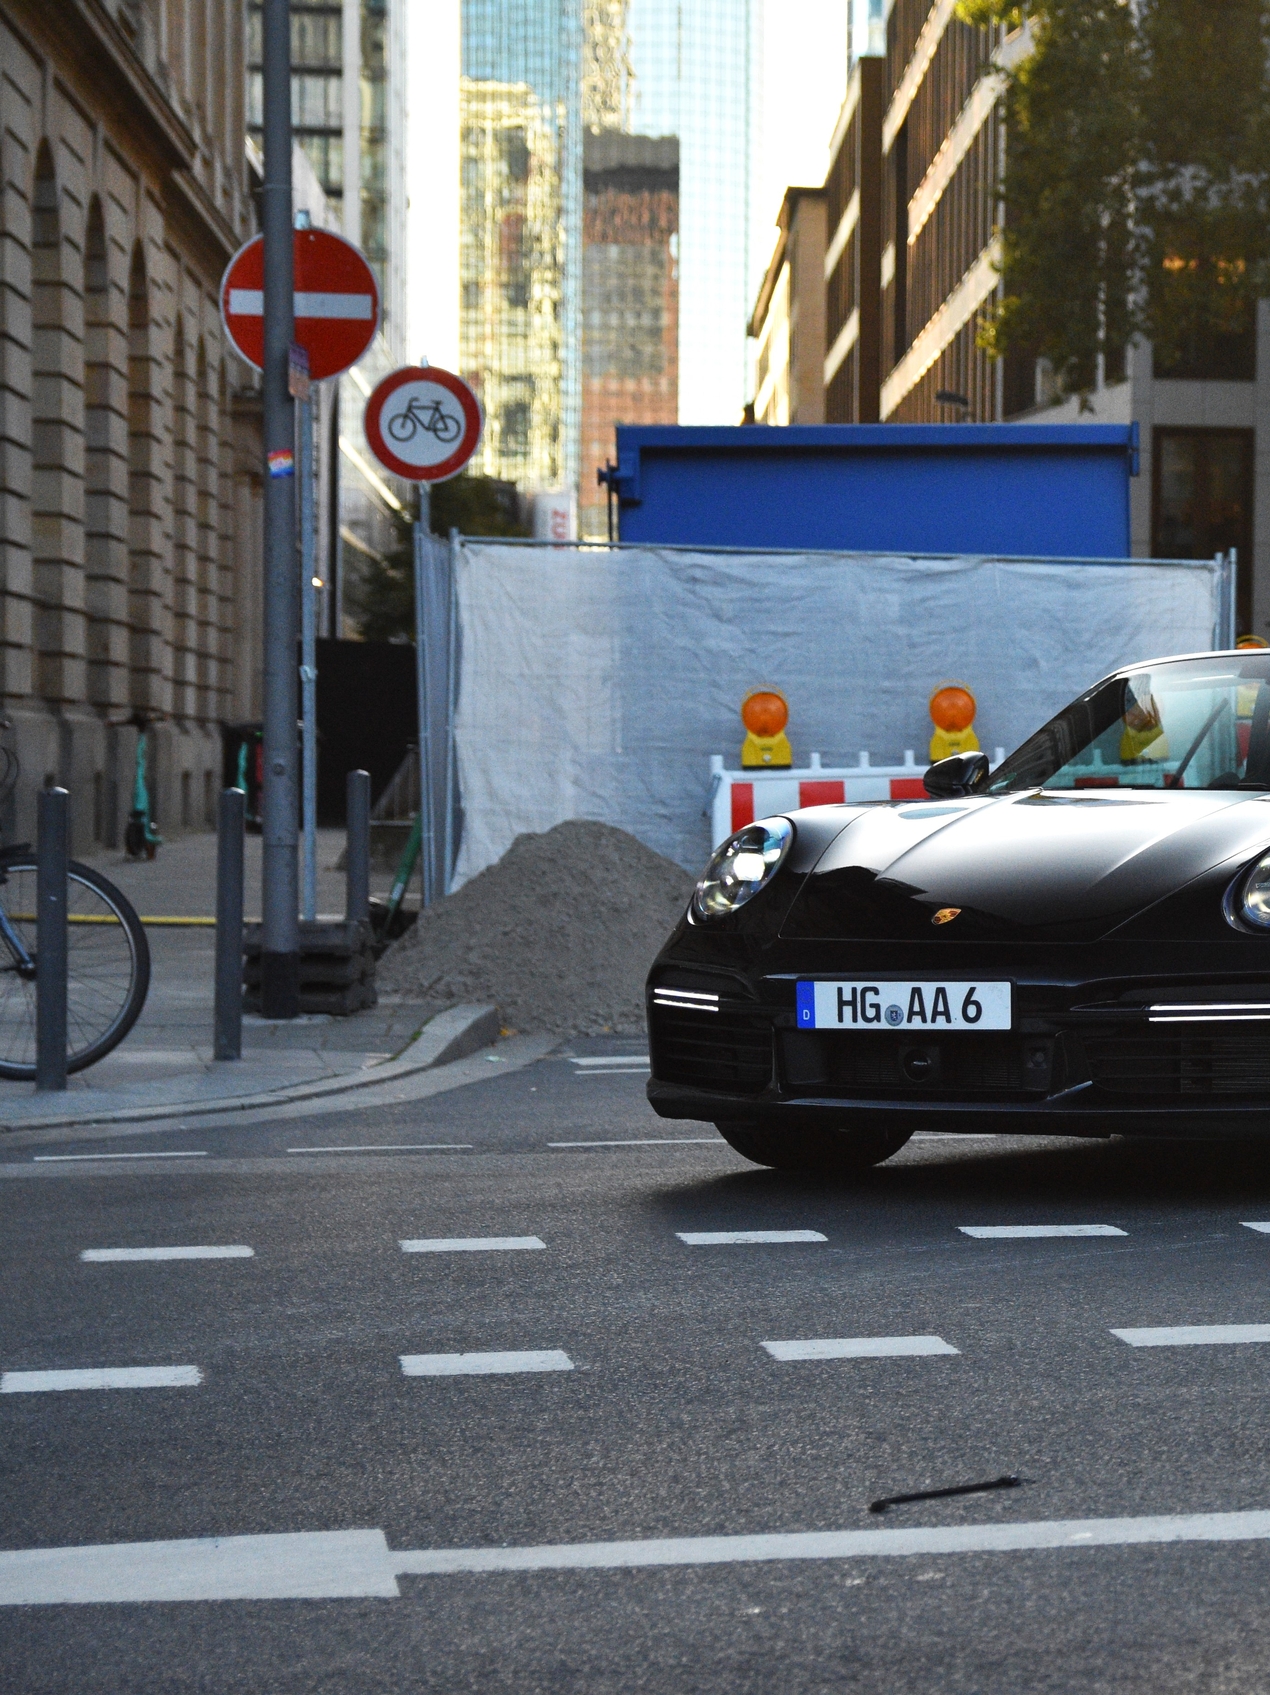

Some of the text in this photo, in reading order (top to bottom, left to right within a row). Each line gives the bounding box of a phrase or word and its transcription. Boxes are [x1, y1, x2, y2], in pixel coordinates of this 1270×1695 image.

[802, 986, 983, 1024] D HG AA 6
